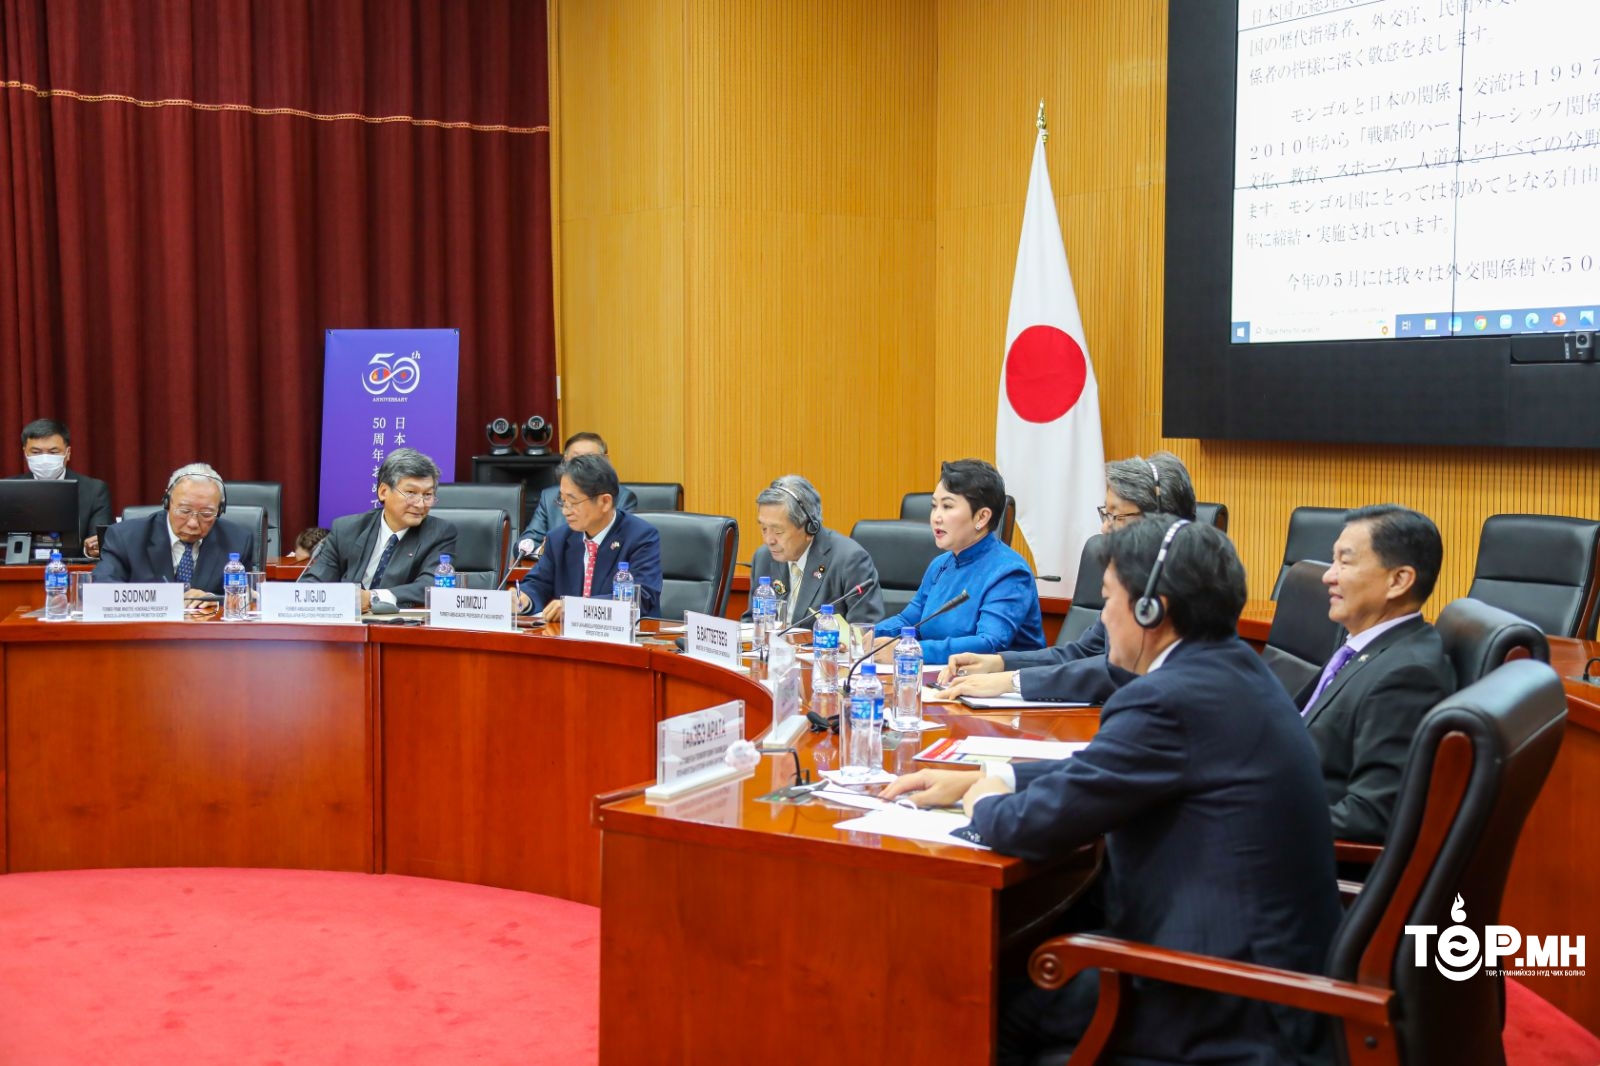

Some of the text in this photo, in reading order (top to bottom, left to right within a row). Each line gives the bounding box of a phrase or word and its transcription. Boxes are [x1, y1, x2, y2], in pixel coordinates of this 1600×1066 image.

[394, 416, 406, 446] 日本
[114, 589, 156, 603] D.SODNOM
[304, 589, 327, 603] JIGJID
[456, 595, 488, 610] SHIMIZU.T
